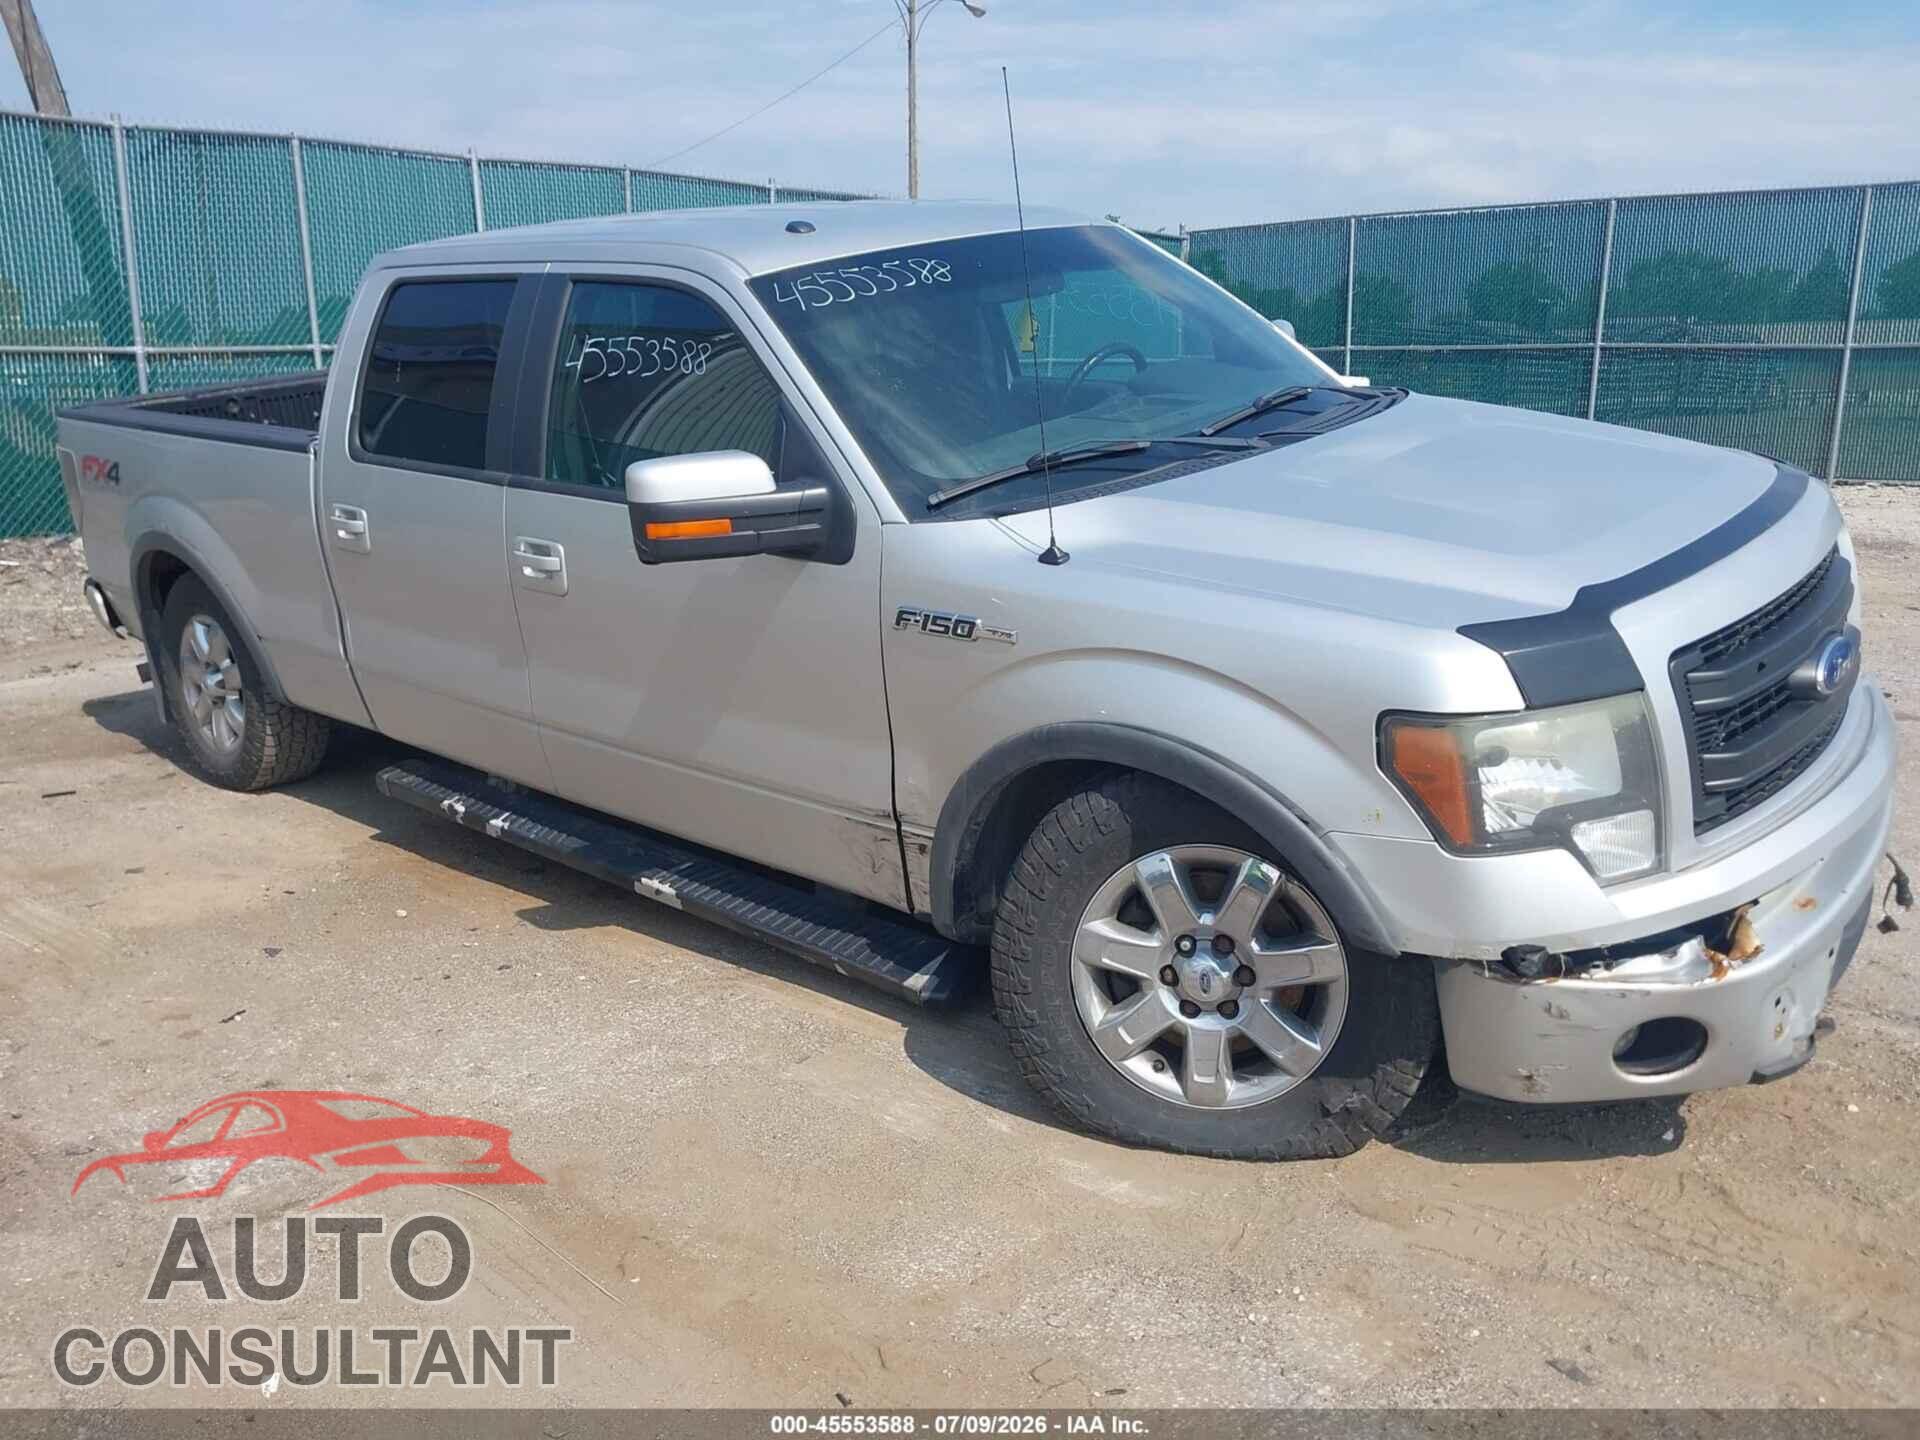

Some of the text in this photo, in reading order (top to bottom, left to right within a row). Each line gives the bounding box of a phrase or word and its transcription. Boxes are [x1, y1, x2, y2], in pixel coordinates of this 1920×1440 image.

[774, 258, 952, 311] 45553588
[565, 333, 712, 386] 45553588
[81, 455, 120, 486] FX4
[894, 607, 977, 640] F-150
